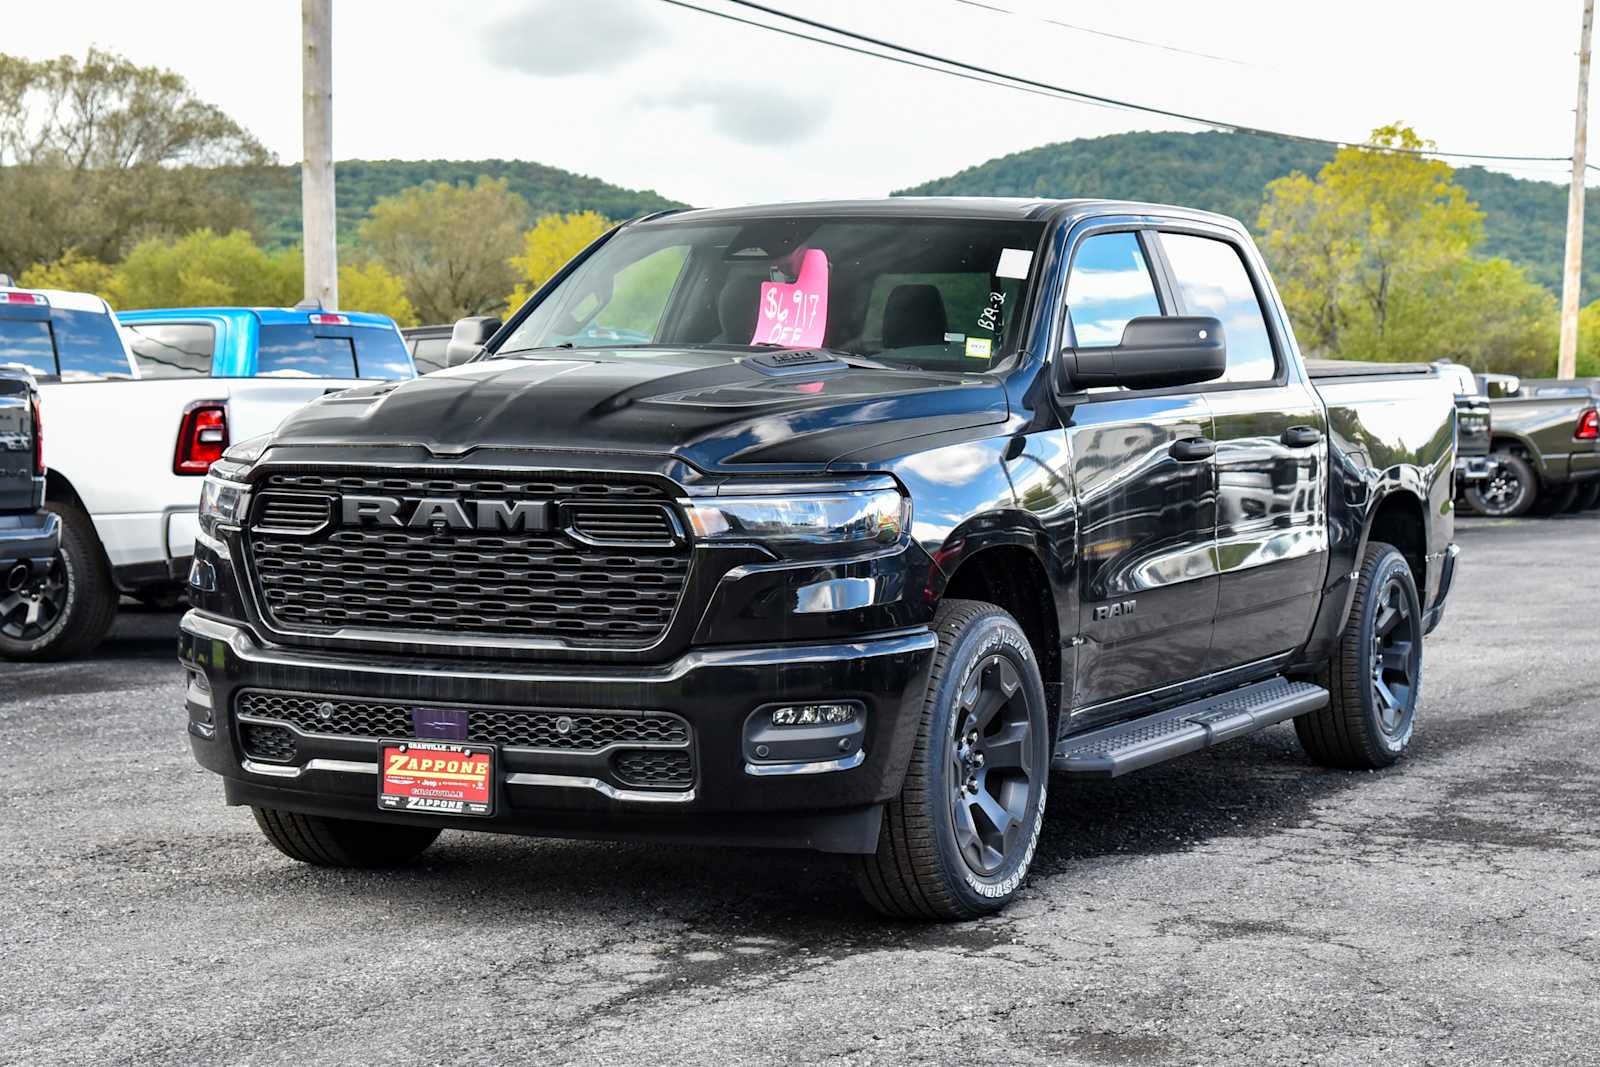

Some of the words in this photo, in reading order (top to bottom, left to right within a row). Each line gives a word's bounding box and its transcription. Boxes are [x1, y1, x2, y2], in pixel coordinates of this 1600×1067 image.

[767, 322, 804, 346] OFF
[341, 494, 549, 530] RAM
[1092, 599, 1137, 621] RAM
[385, 754, 489, 781] ZAPPONE
[405, 796, 464, 813] ZAPPONE
